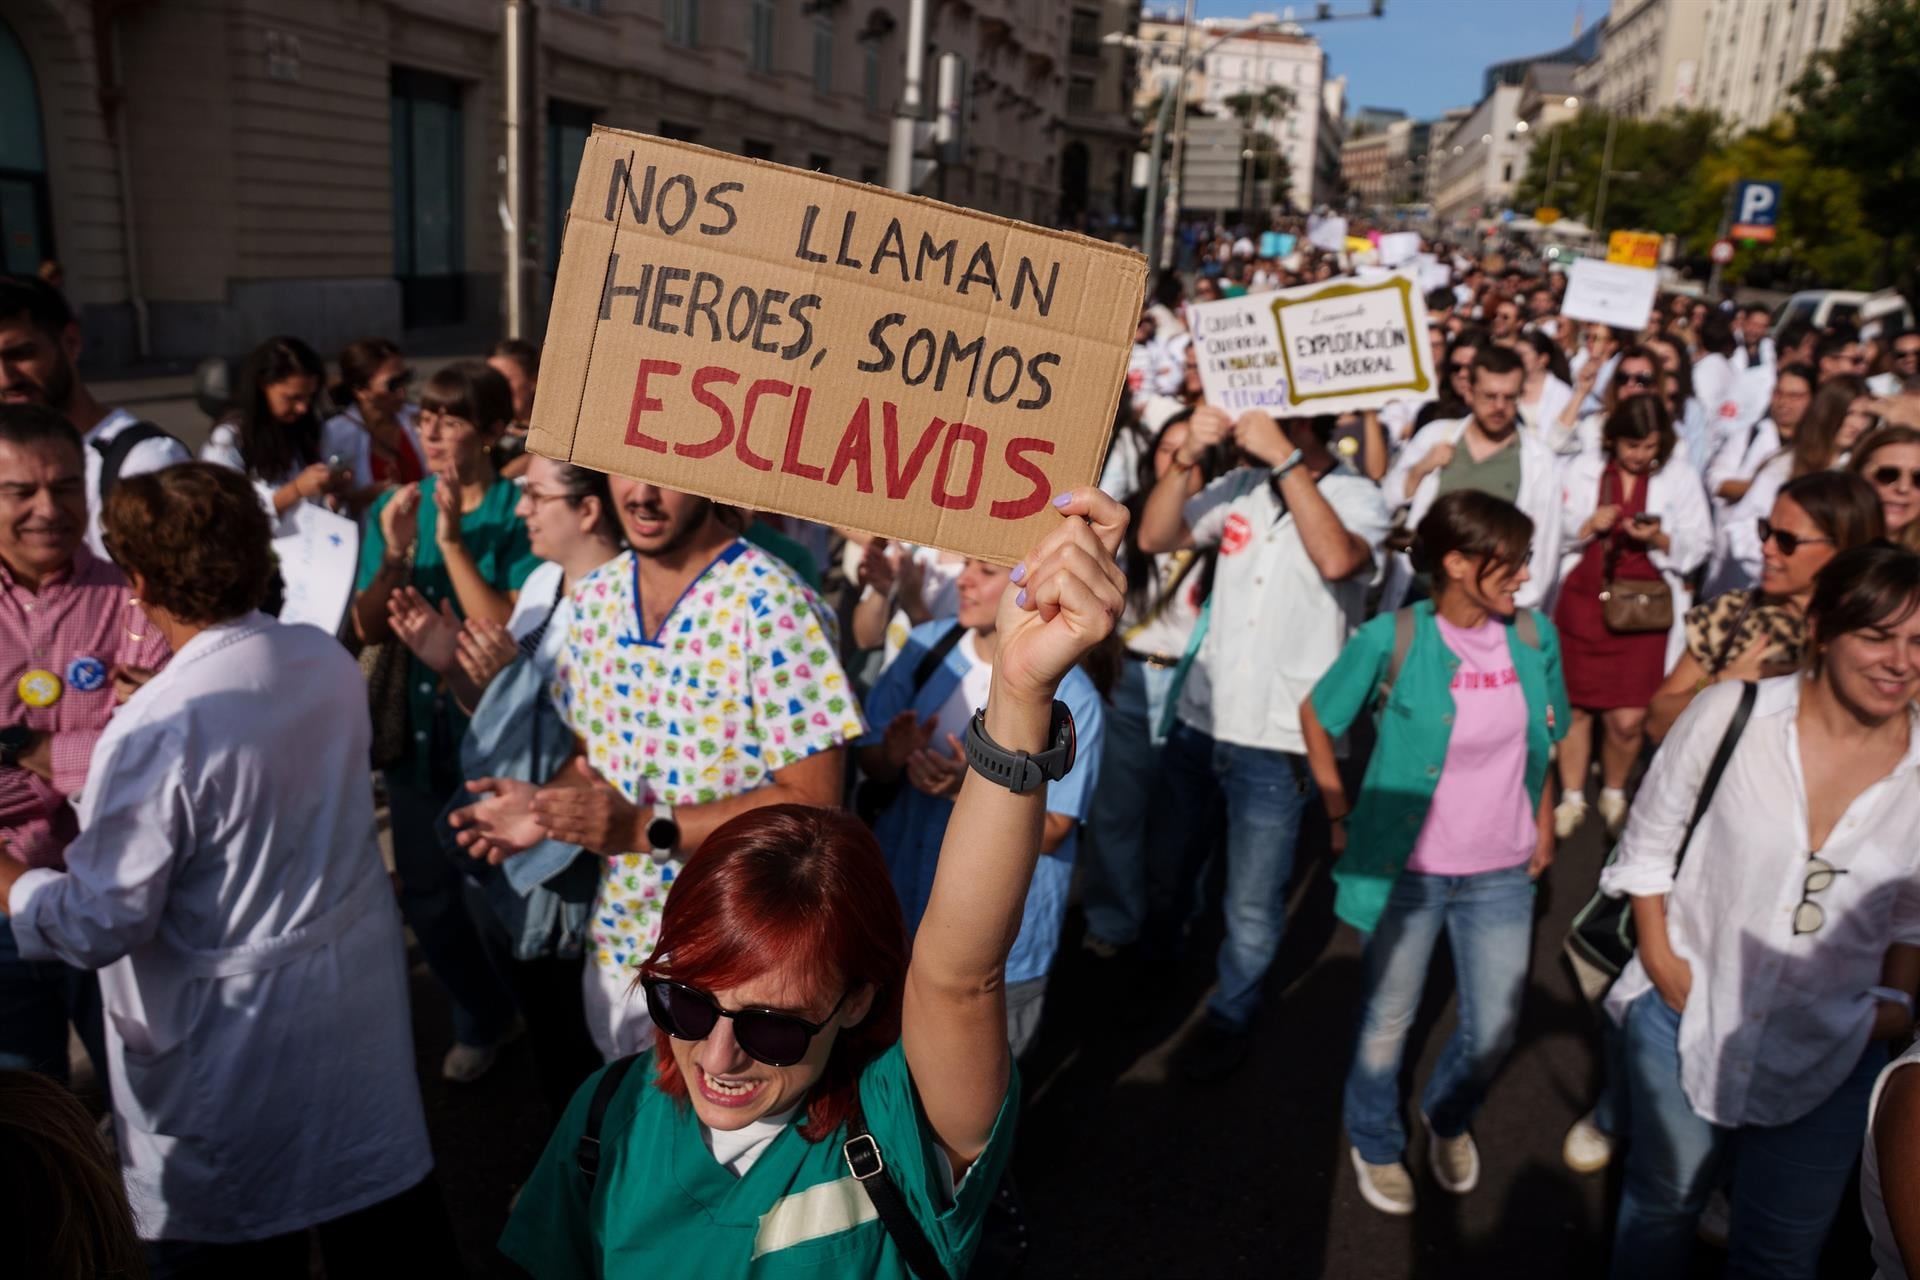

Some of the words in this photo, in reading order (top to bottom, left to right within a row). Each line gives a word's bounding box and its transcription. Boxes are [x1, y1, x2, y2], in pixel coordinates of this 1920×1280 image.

[604, 157, 745, 237] NOS
[795, 204, 1061, 317] LLAMAN
[1741, 184, 1775, 223] P
[600, 253, 828, 371] HEROES,
[857, 312, 1062, 411] SOMOS
[1295, 319, 1406, 357] EXPLOTACIÓN
[1322, 355, 1396, 380] LABORAL
[624, 358, 1056, 521] ESCLAVOS
